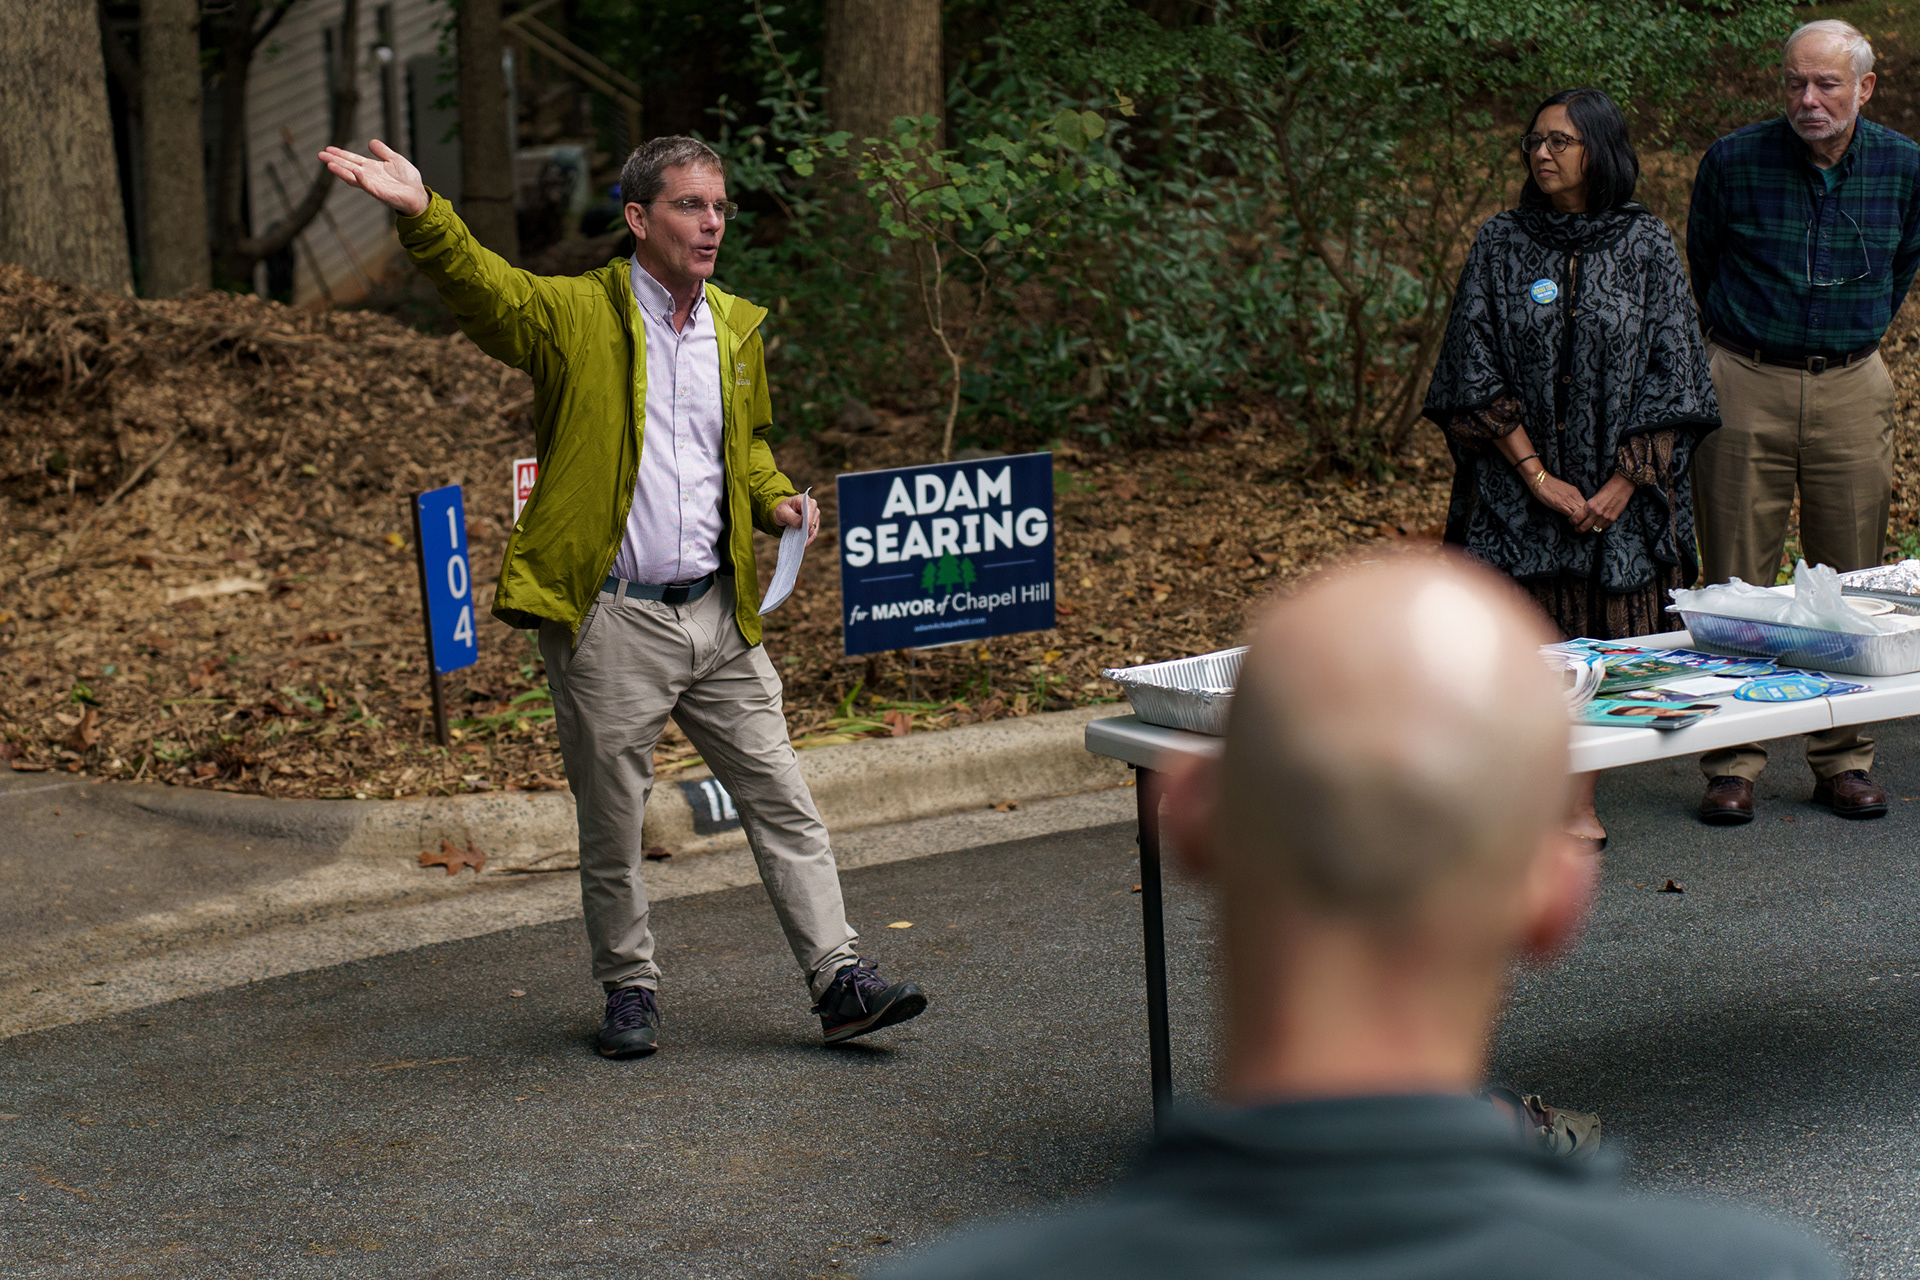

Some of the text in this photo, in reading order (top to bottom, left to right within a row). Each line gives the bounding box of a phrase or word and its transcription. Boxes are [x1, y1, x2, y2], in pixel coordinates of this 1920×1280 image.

[881, 465, 1012, 519] ADAM
[845, 507, 1049, 567] SEARING
[446, 506, 473, 648] 104
[849, 582, 1050, 626] for MAYOR of Chapel Hill
